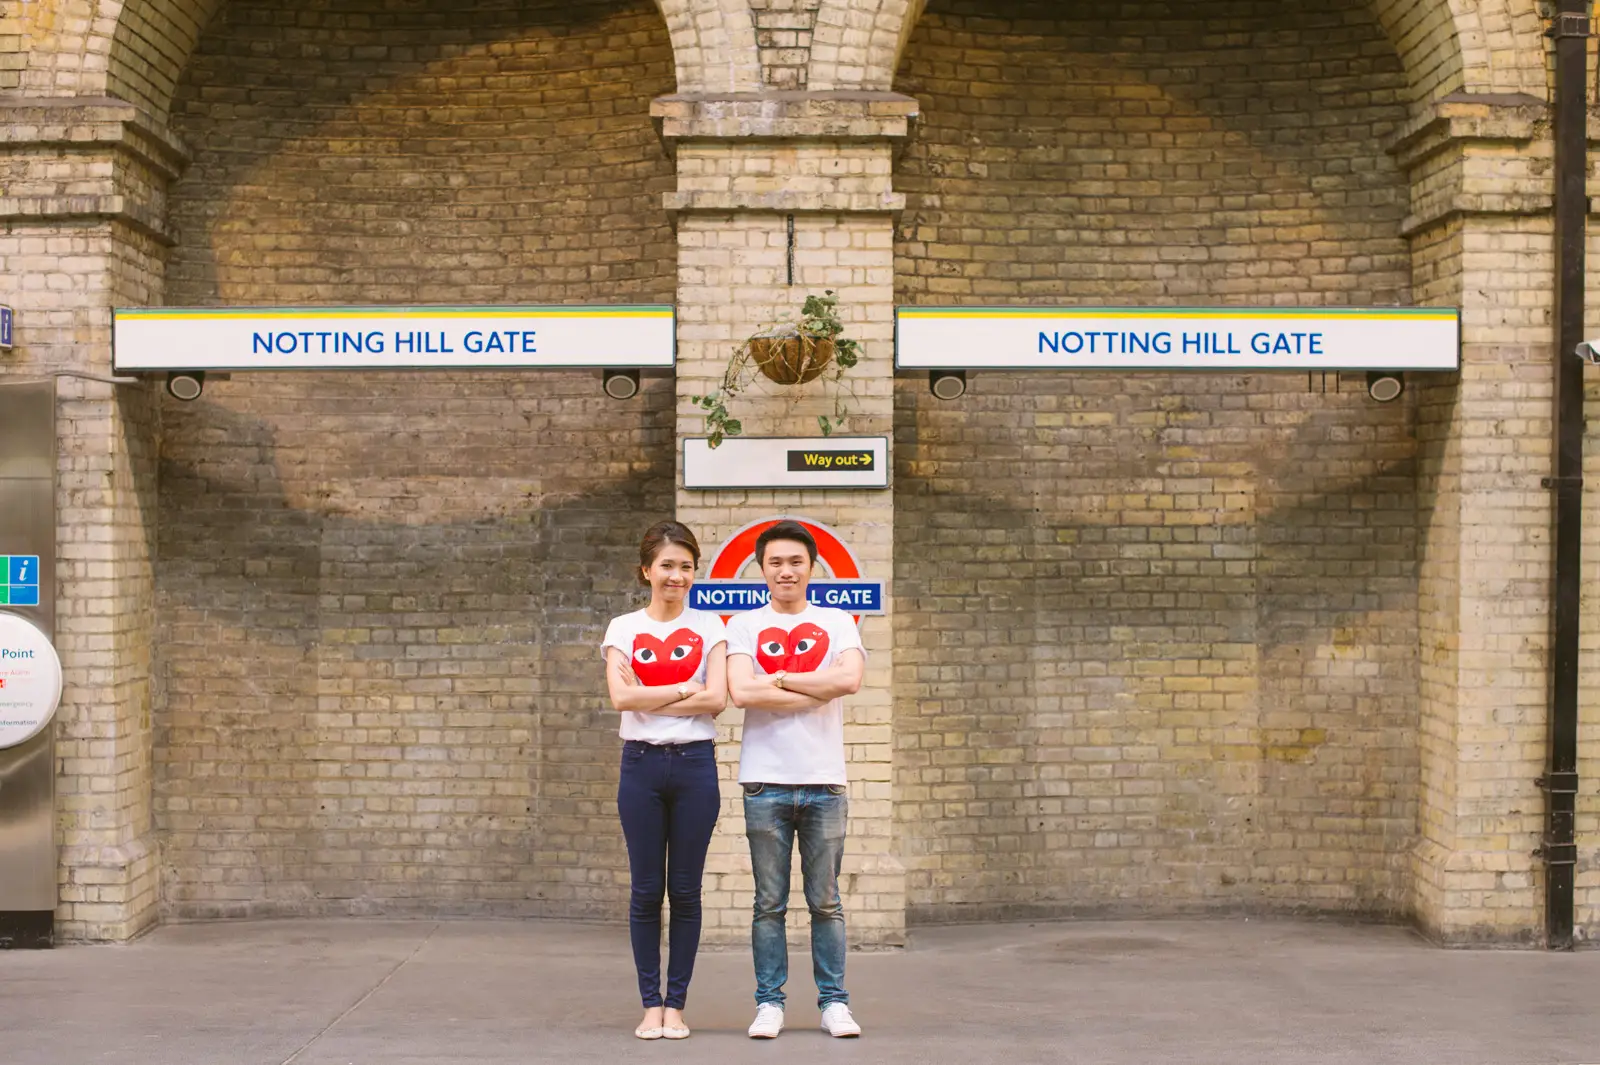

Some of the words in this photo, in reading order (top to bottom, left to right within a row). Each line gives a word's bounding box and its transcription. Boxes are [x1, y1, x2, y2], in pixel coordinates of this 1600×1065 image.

[253, 331, 384, 354] NOTTING
[394, 331, 454, 353] HILL
[463, 331, 537, 353] GATE
[1039, 331, 1172, 354] NOTTING
[1182, 331, 1241, 354] HILL
[1250, 331, 1324, 354] GATE
[803, 453, 833, 467] Way
[835, 454, 858, 465] out
[825, 589, 872, 604] GATE
[2, 648, 35, 659] Point
